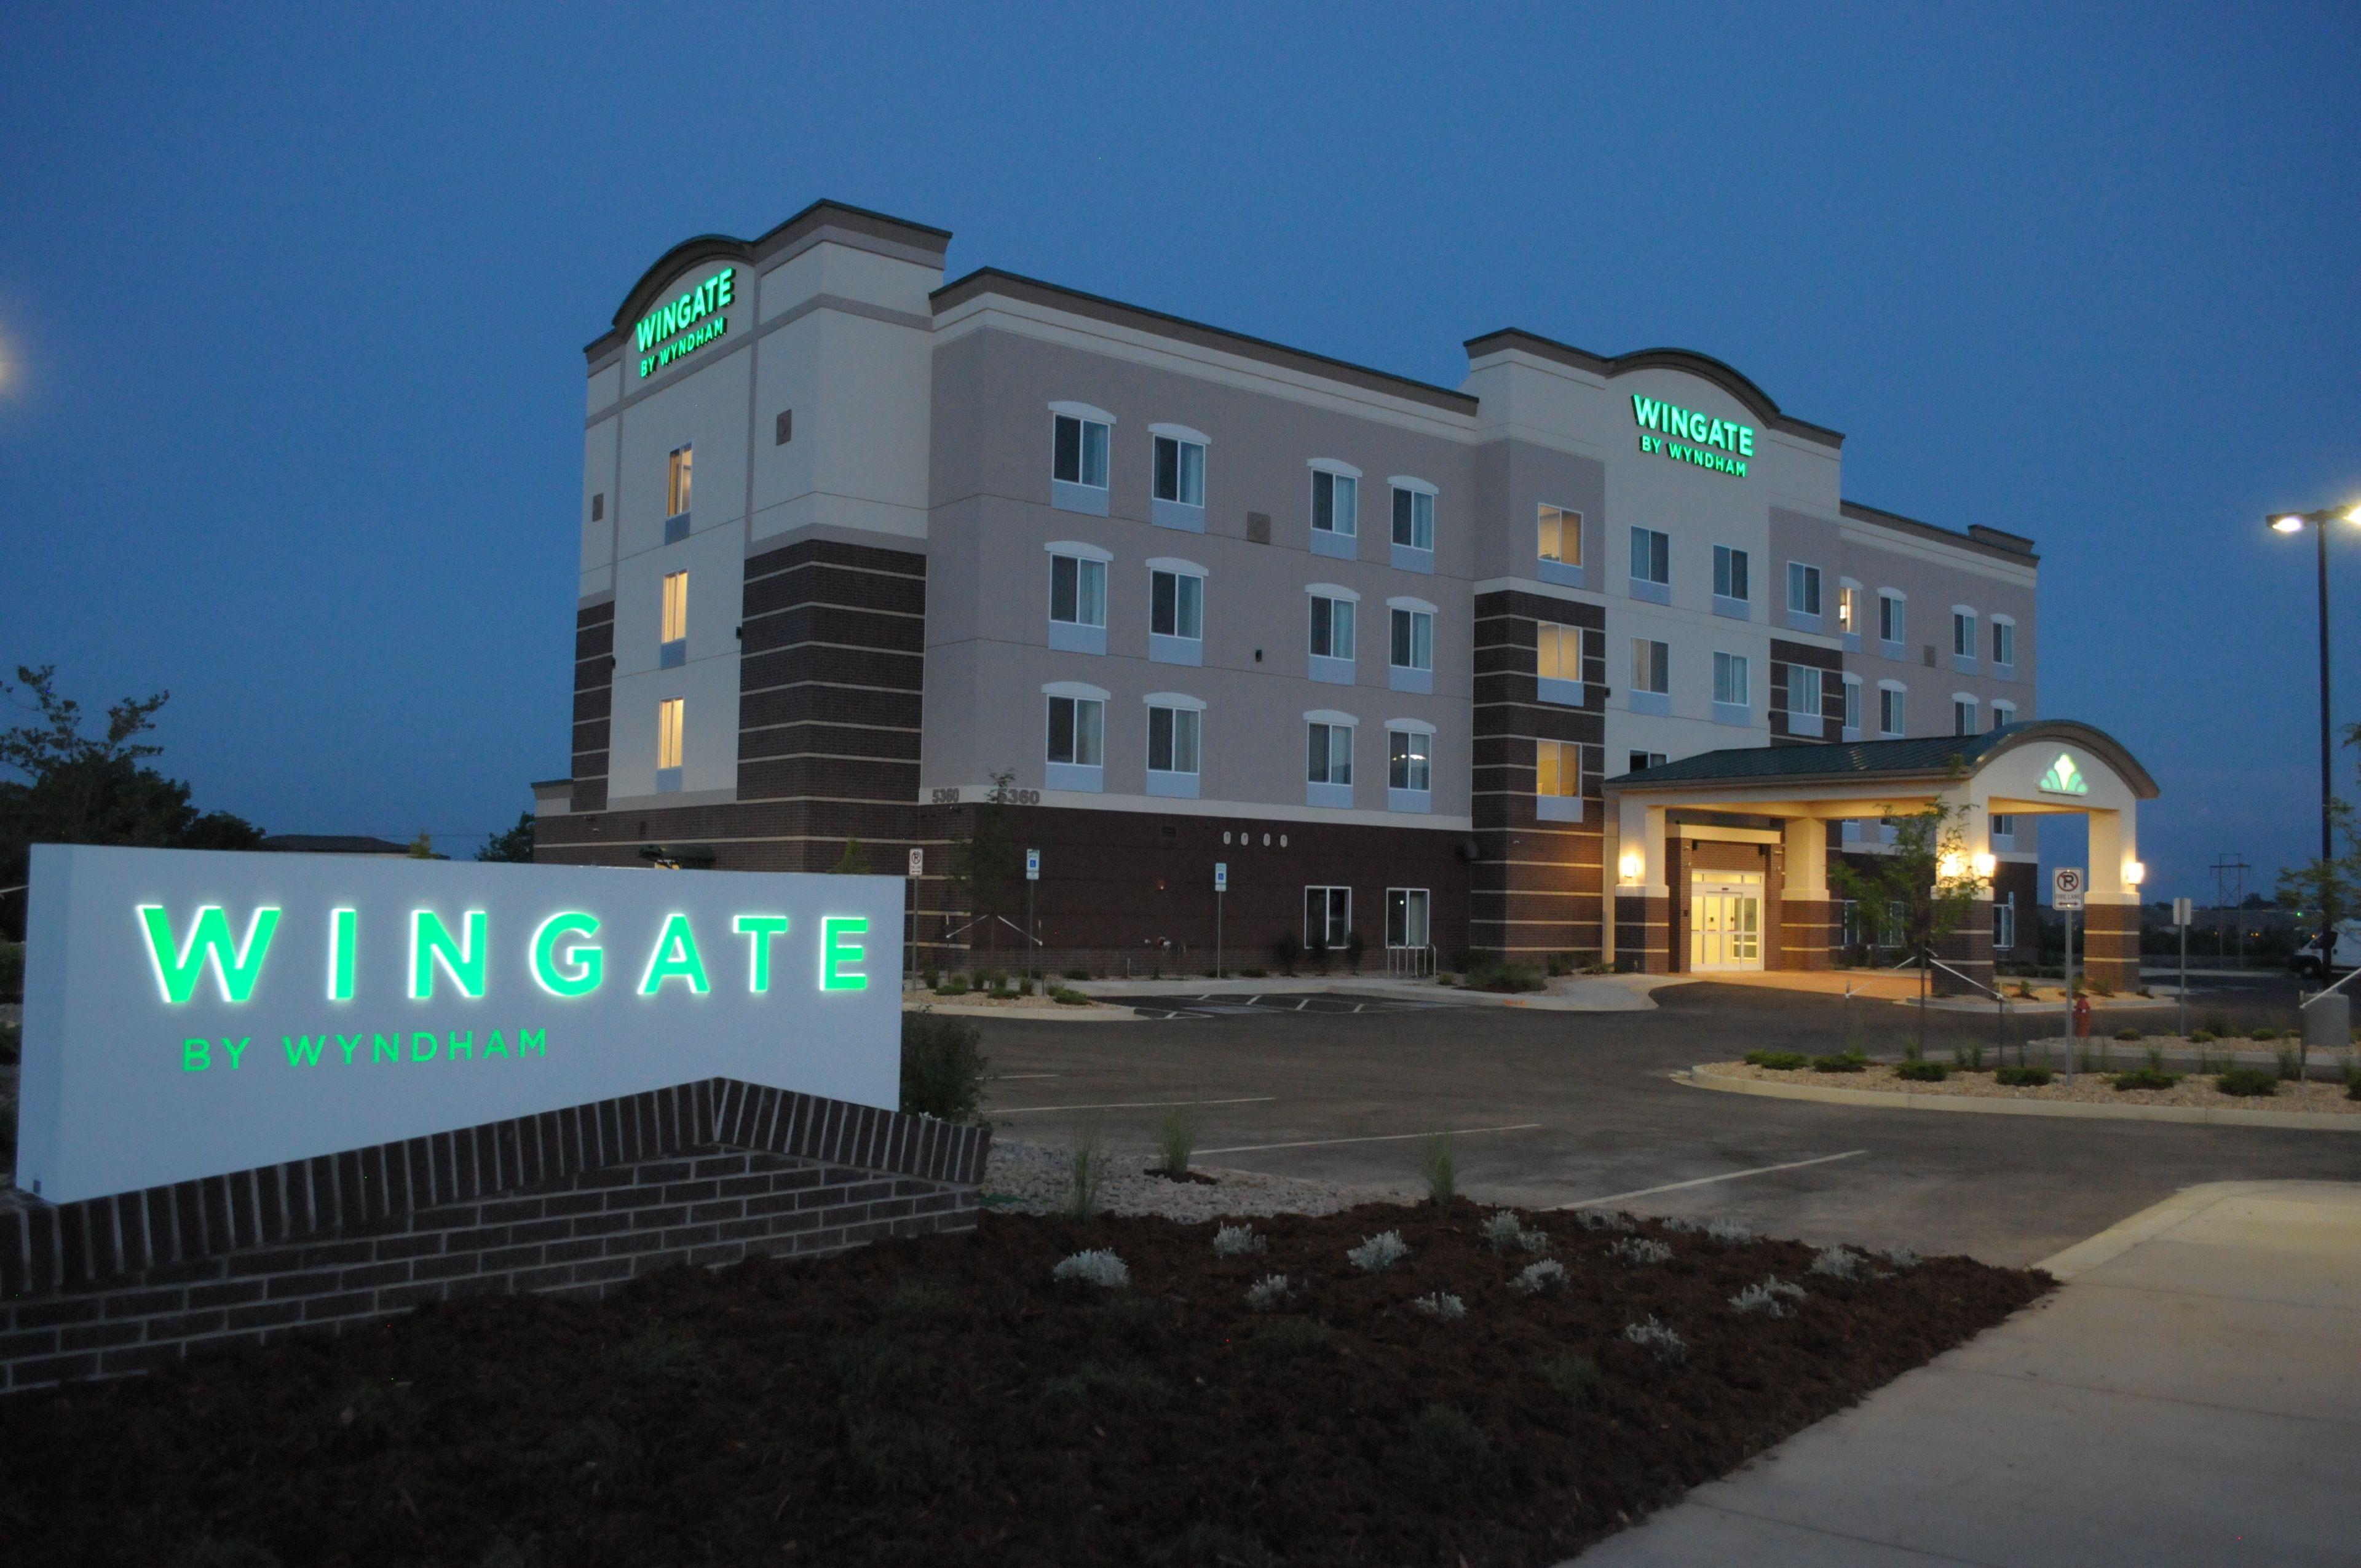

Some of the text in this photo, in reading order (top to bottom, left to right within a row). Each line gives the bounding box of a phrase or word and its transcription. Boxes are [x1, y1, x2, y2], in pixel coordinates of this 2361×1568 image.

[636, 268, 733, 352] WINGATE
[640, 317, 724, 378] BY WYNDHAM
[1634, 395, 1754, 457] WINGATE
[1642, 435, 1747, 477] BY WYNDHAM
[932, 788, 960, 803] 5360
[997, 788, 1040, 805] 5360
[136, 904, 869, 1007] WINGATE
[181, 1028, 547, 1072] BY WYNDHAM
